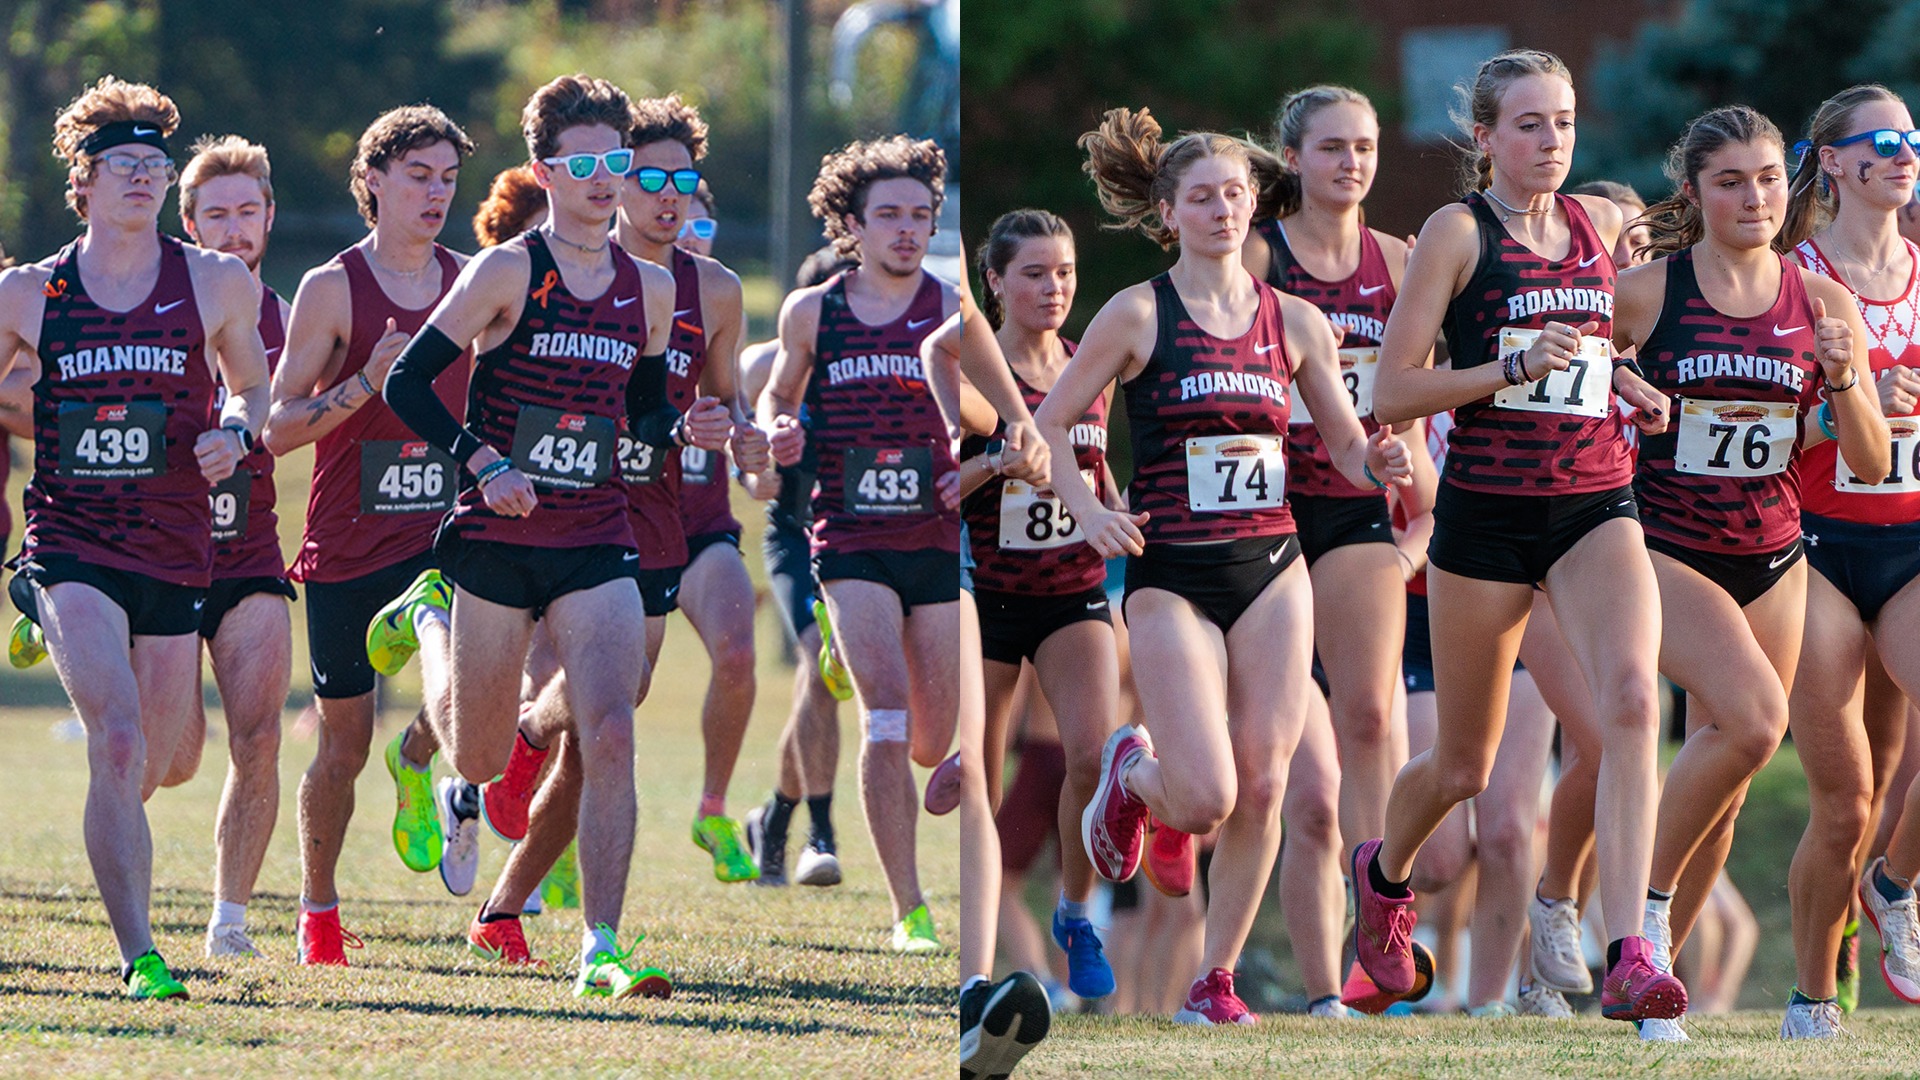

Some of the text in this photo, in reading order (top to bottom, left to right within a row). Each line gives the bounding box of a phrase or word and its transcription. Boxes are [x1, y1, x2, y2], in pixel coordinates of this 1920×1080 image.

[1507, 287, 1614, 321] ROANOKE
[1326, 312, 1384, 343] NOKE
[57, 345, 188, 382] ROANOKE
[527, 331, 638, 371] ROANOKE
[827, 353, 927, 386] ROANOK
[1180, 371, 1286, 406] ROANOKE
[1676, 353, 1805, 393] ROANOKE
[75, 426, 150, 465] 439
[529, 434, 598, 476] 434
[617, 437, 654, 471] 23
[1707, 423, 1771, 470] 76
[378, 461, 445, 499] 456
[857, 467, 920, 502] 433
[1214, 458, 1268, 503] 74
[1025, 501, 1077, 542] 85
